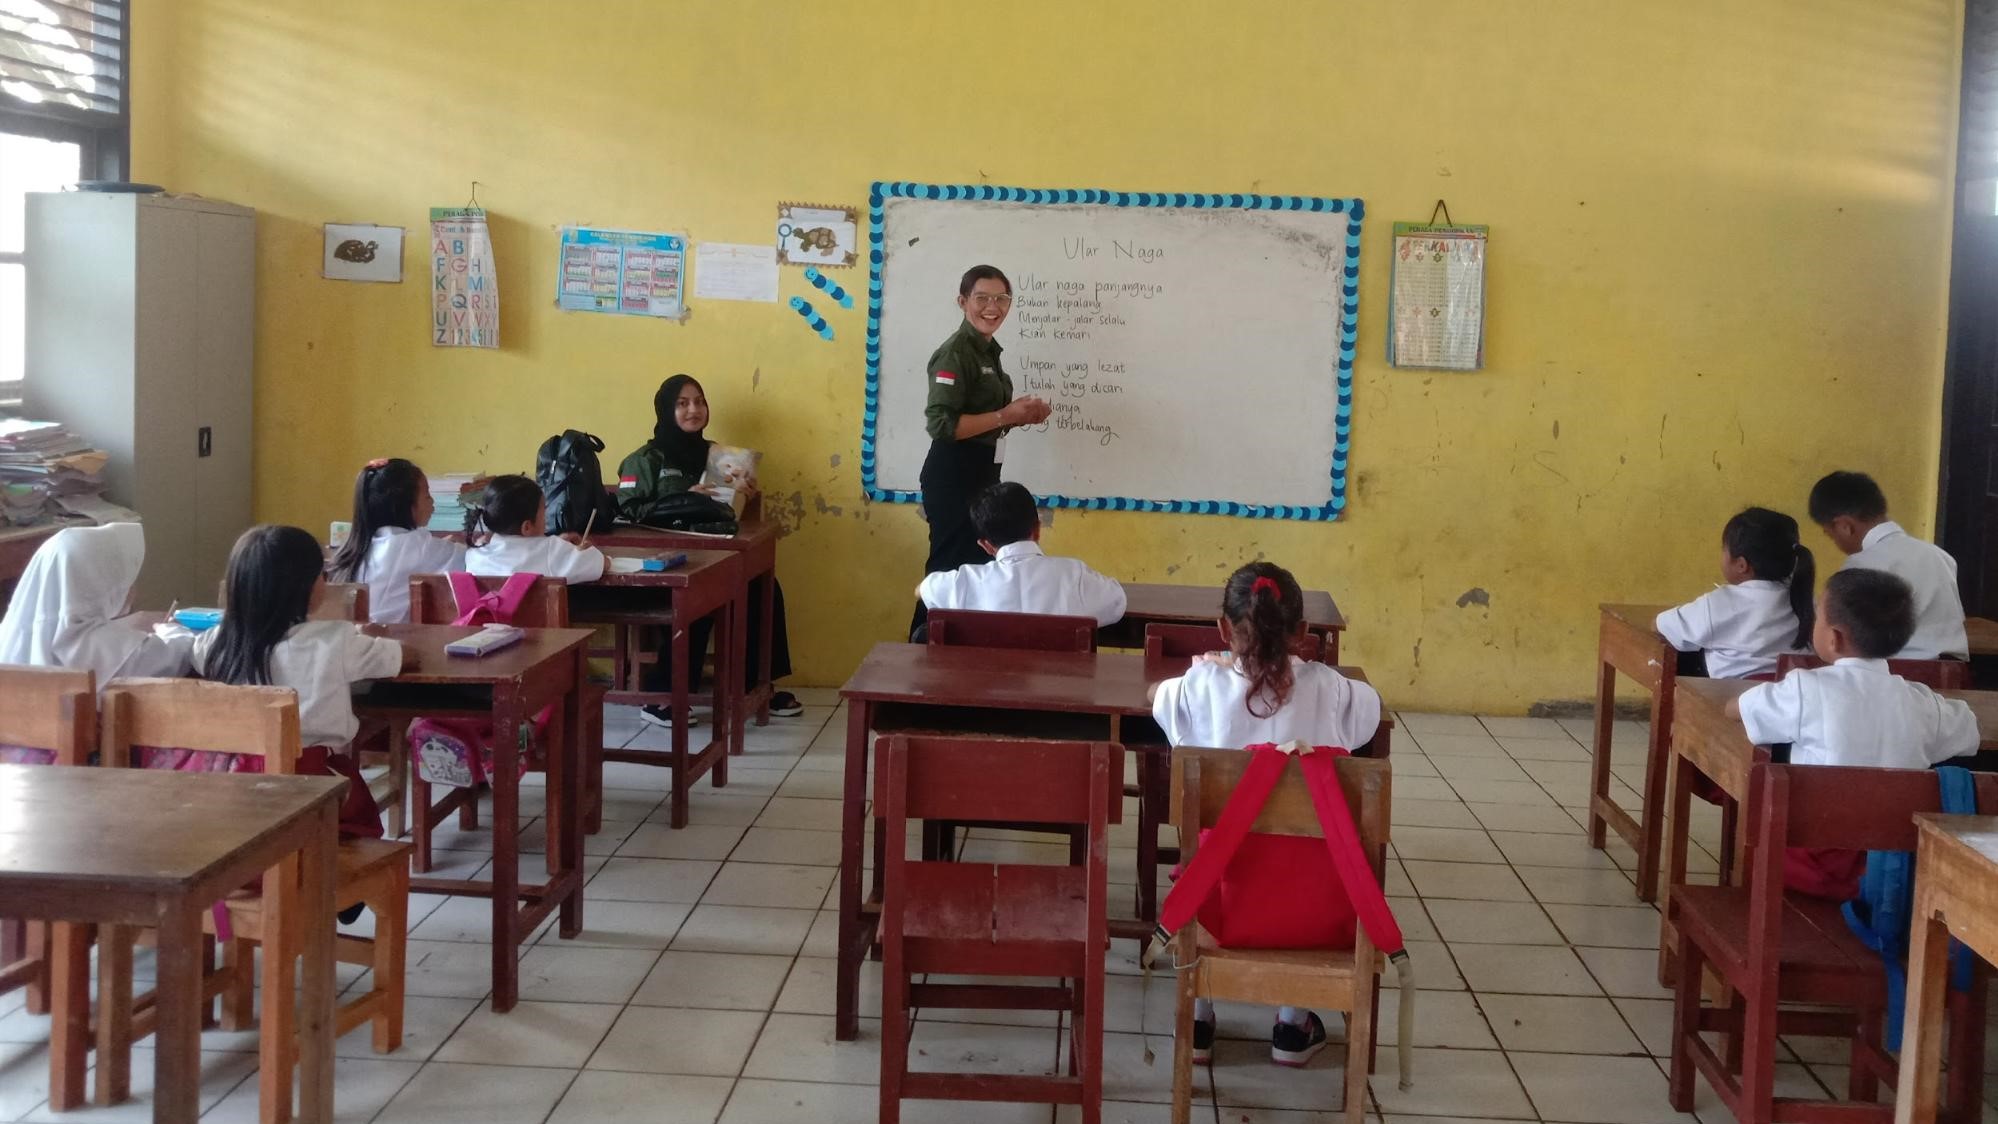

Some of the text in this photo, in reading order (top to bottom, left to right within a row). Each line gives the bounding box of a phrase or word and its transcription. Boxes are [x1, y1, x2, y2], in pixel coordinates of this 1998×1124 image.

[434, 240, 464, 254] A B
[1063, 237, 1165, 263] Ular Naga
[437, 257, 480, 273] F G H
[436, 275, 447, 290] K
[469, 276, 483, 291] M
[1018, 272, 1163, 302] Ular naga panjangnya
[437, 294, 447, 308] P
[452, 294, 467, 309] Q
[472, 294, 480, 309] R
[1016, 295, 1102, 314] Bukan kepalang
[436, 311, 447, 326] U
[453, 312, 466, 326] V
[436, 329, 447, 344] Z
[1018, 328, 1046, 340] Kian
[1020, 354, 1125, 380] Umpan yang lezat
[1023, 374, 1055, 392] Itulah
[1060, 383, 1086, 398] yang
[1056, 416, 1121, 446] terbelakang
